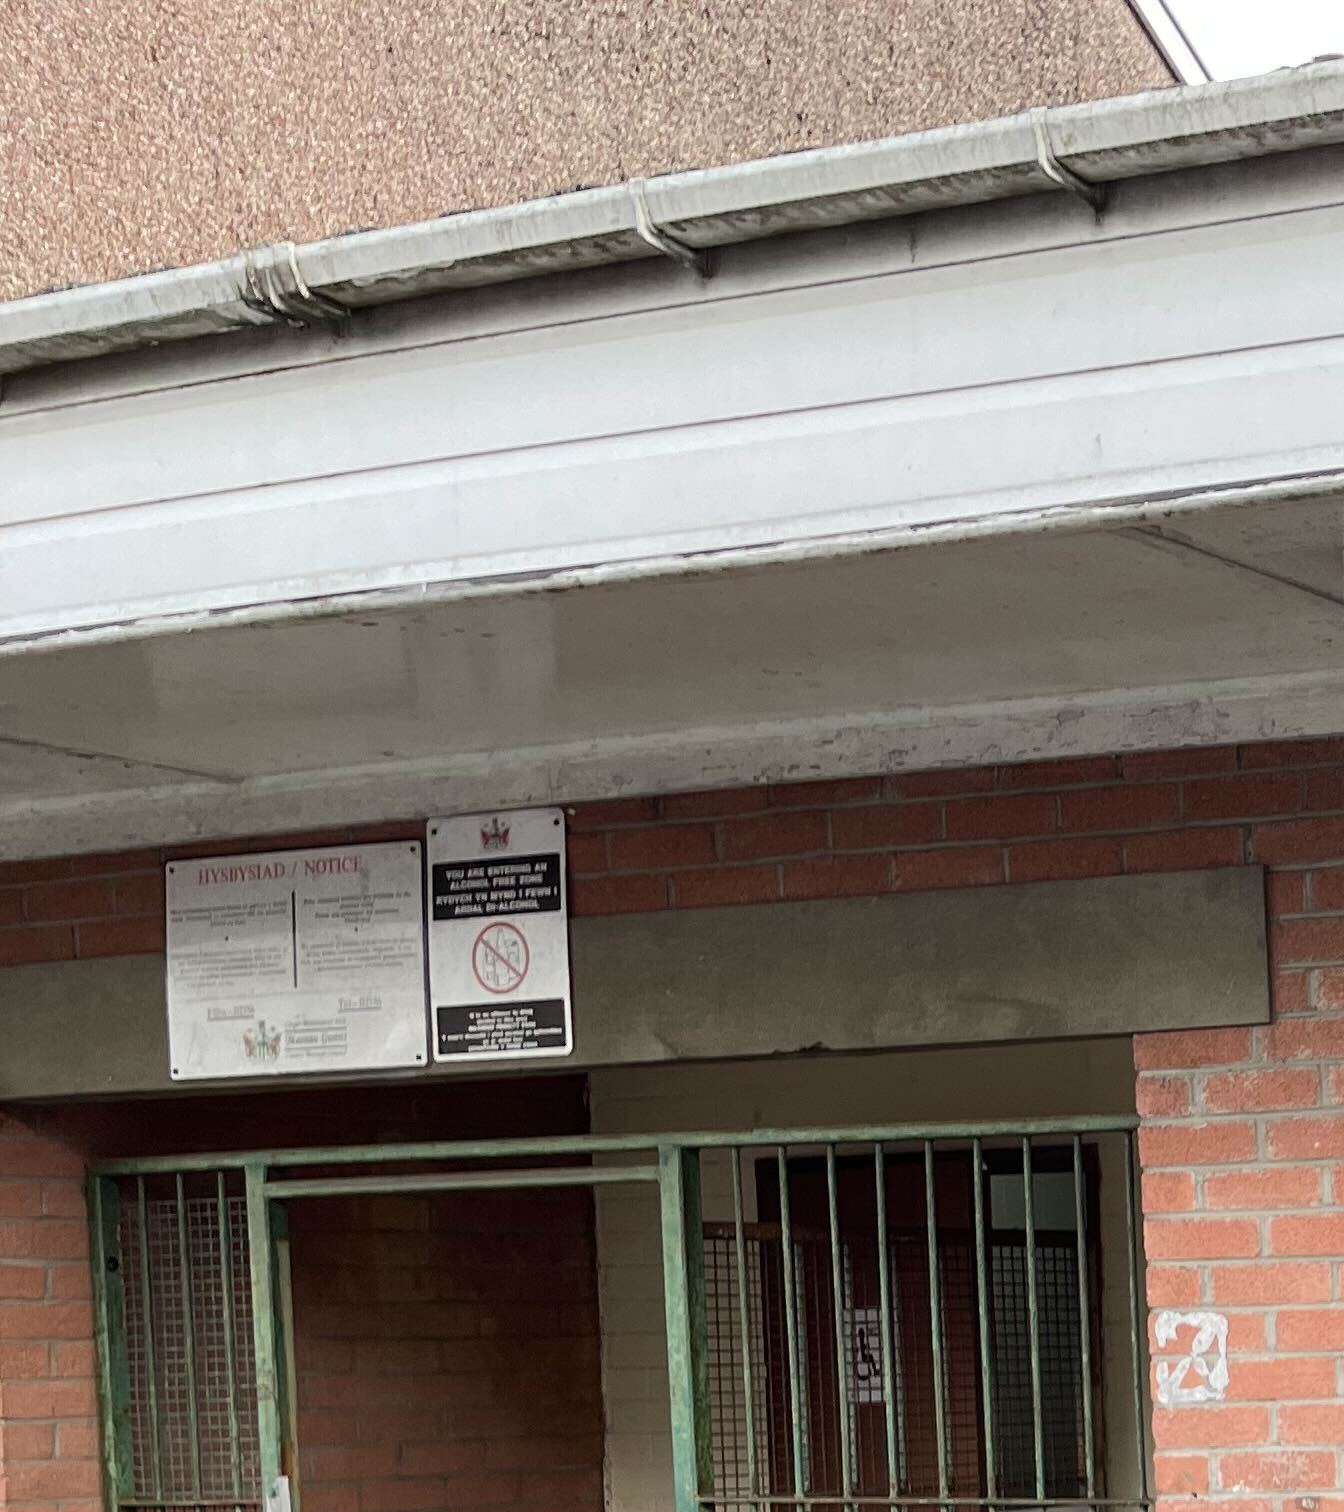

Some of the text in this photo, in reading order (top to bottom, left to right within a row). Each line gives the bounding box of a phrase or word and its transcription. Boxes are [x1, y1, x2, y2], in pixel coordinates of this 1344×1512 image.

[199, 863, 286, 885] HYSBYSIAD
[304, 856, 362, 876] NOTICE
[487, 863, 531, 877] ENTERING
[450, 878, 490, 891] ALCOHOL
[493, 876, 516, 888] FREE
